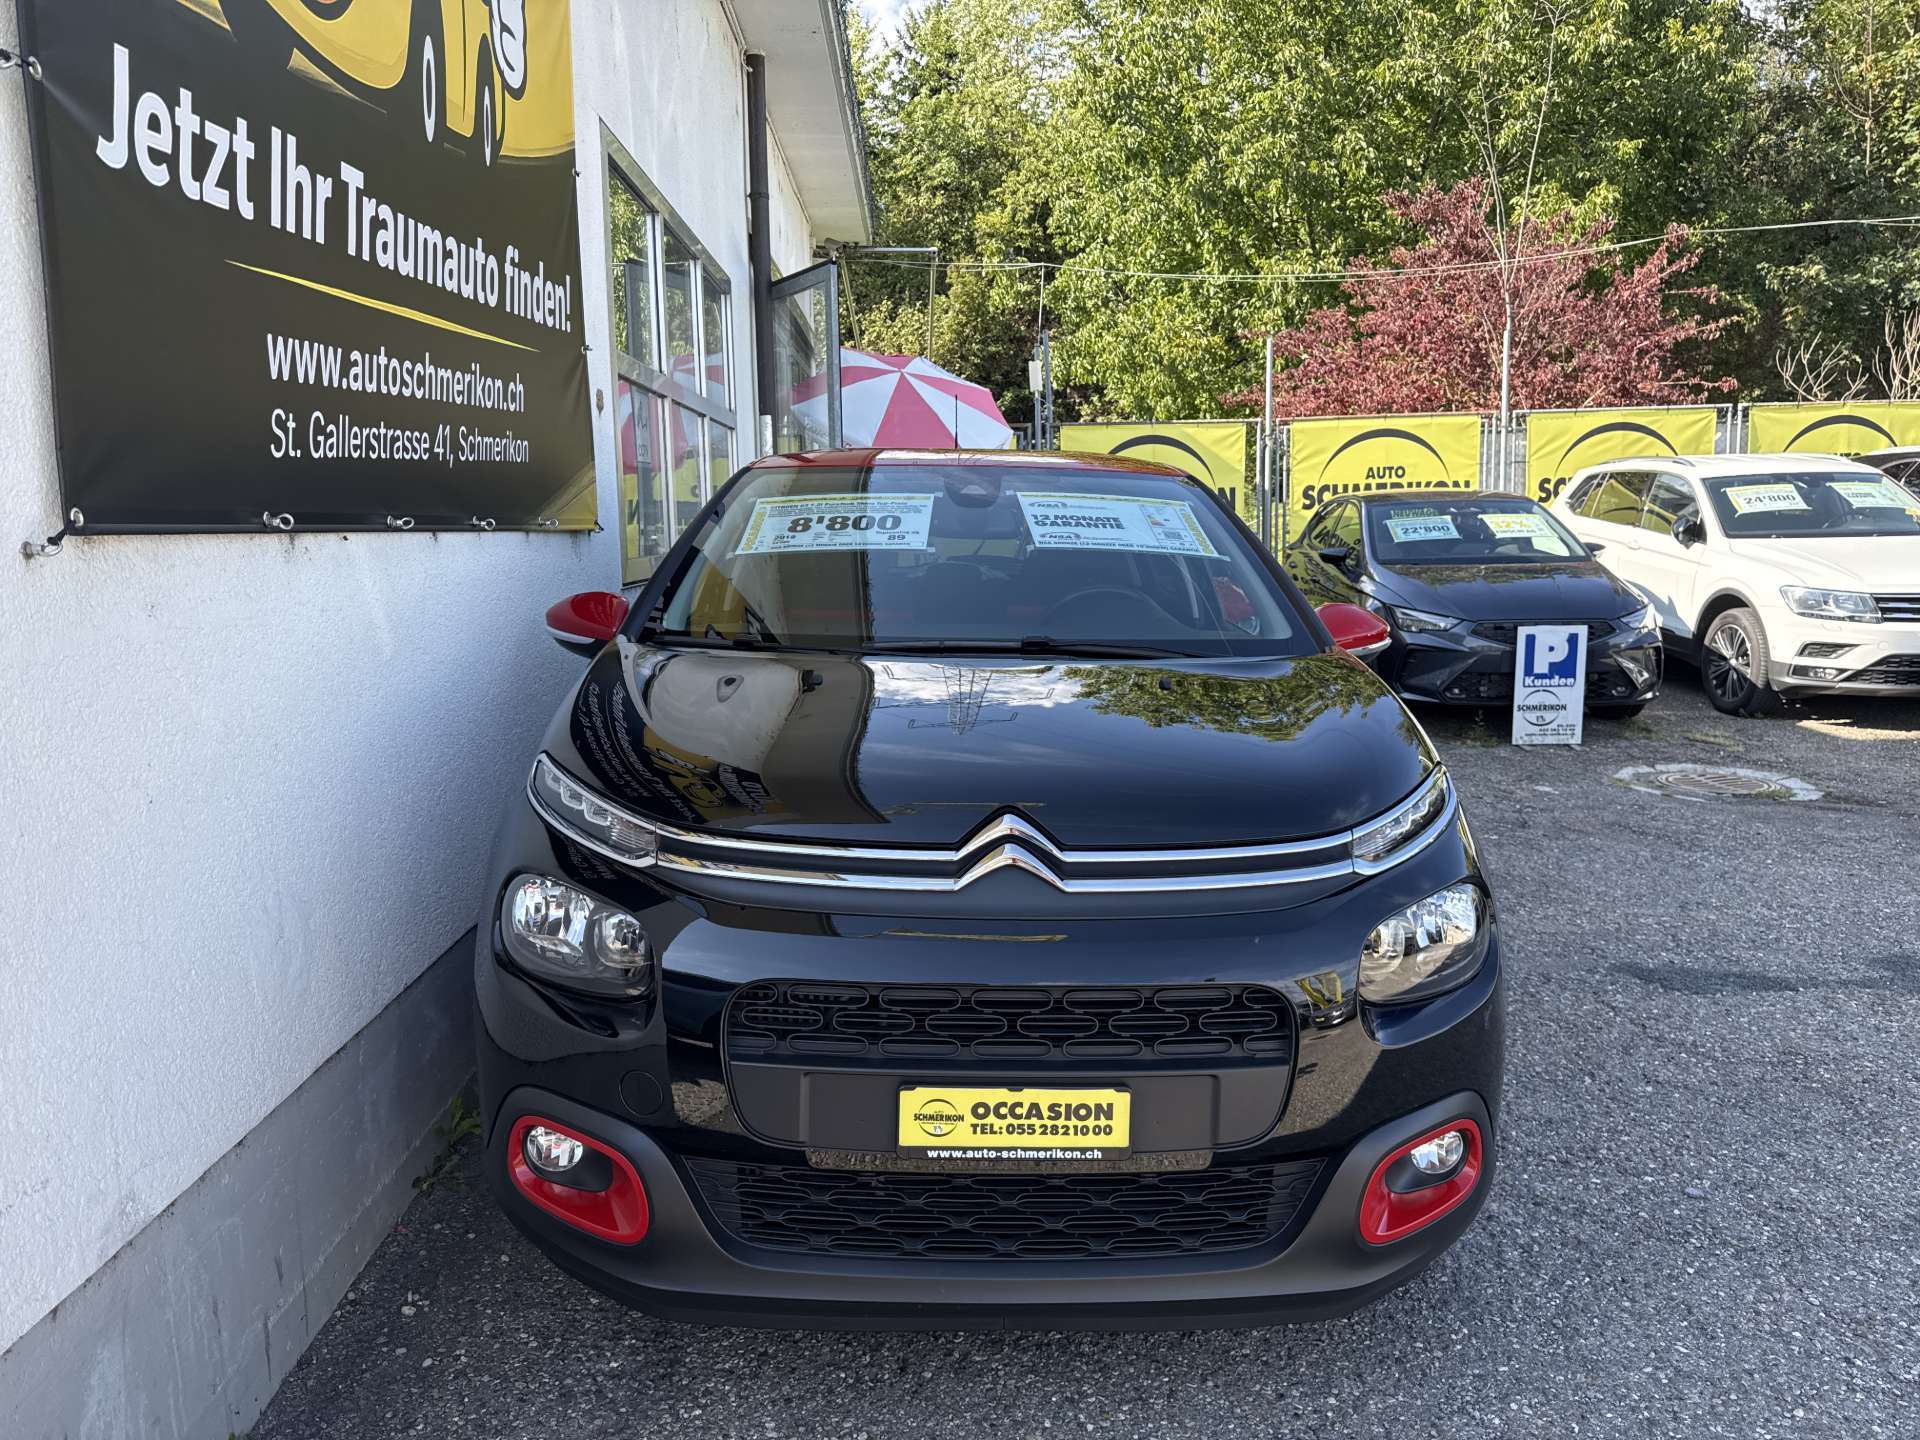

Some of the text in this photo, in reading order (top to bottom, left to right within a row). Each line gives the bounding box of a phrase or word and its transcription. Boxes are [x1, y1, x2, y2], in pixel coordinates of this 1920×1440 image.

[96, 43, 572, 333] Jetzt Ihr Traumauto finden!
[267, 332, 525, 413] www.autoschmerikon.ch
[269, 408, 529, 469] St. Gallerstrasse 41, Schmerikon
[1365, 465, 1406, 480] AUTO
[1743, 494, 1797, 505] 24'800
[1053, 514, 1121, 522] MONATE
[787, 515, 902, 533] 8'800
[1034, 521, 1125, 530] GARANTIE
[1524, 676, 1575, 687] Kunden
[1517, 704, 1567, 712] SCHMERIKON
[970, 1101, 1114, 1121] OCCASION
[913, 1112, 965, 1123] SCHMERIKON
[927, 1148, 1102, 1159] www.auto-schmerikon.ch
